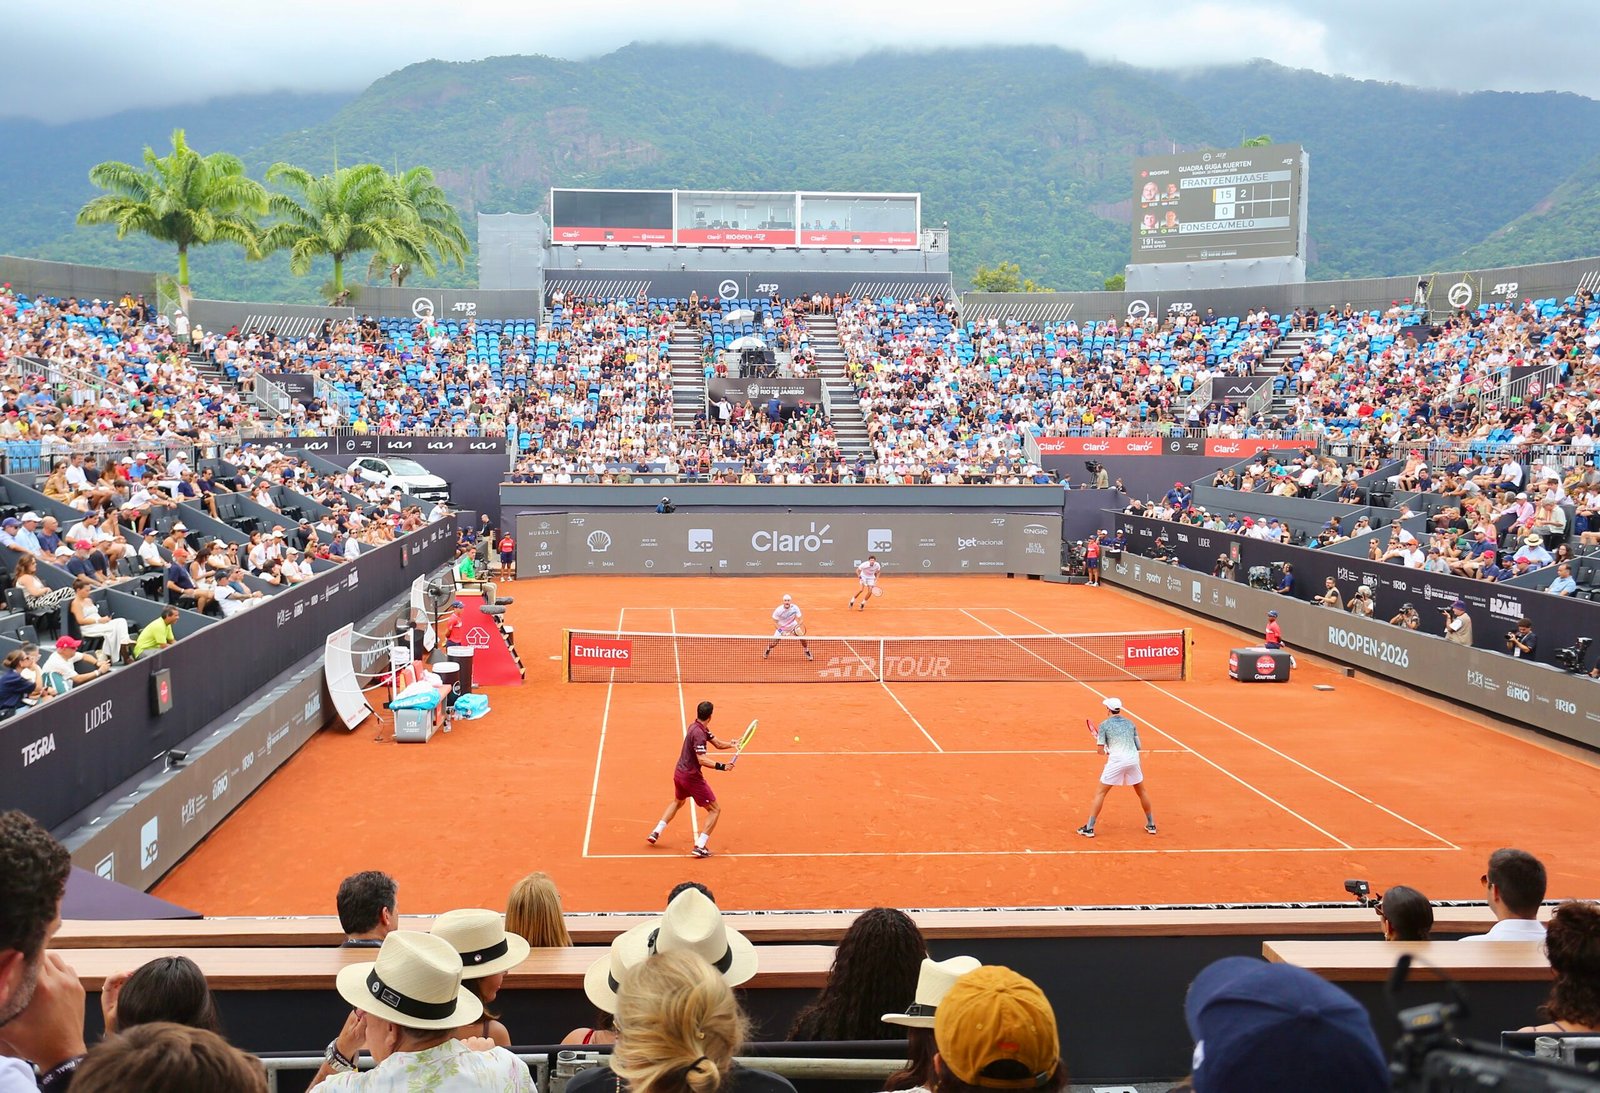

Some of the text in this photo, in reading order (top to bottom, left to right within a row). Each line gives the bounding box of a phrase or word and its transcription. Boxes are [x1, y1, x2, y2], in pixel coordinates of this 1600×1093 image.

[1222, 160, 1252, 169] KUERTEN
[1182, 173, 1269, 188] FRANTZEN/HAASE
[1220, 190, 1246, 199] 15 2
[1222, 206, 1245, 216] 0 1
[1180, 220, 1254, 232] FONSECA/MELO
[756, 284, 779, 292] ATP
[1491, 282, 1518, 295] ATP
[452, 302, 477, 311] ATP
[1168, 303, 1193, 312] ATP
[1039, 442, 1063, 451] Claro
[1083, 442, 1108, 451] Claro
[1127, 442, 1152, 451] Claro
[1214, 445, 1238, 453] Claro
[752, 526, 826, 552] Claro
[1198, 538, 1210, 548] LIDER
[1490, 598, 1524, 618] BRASIL
[574, 645, 628, 659] Emirates
[1128, 646, 1179, 658] Emirates
[817, 656, 950, 677] ATP TOUR
[1514, 687, 1530, 702] RIO
[85, 700, 112, 733] LIDER
[22, 733, 55, 767] TEGRA
